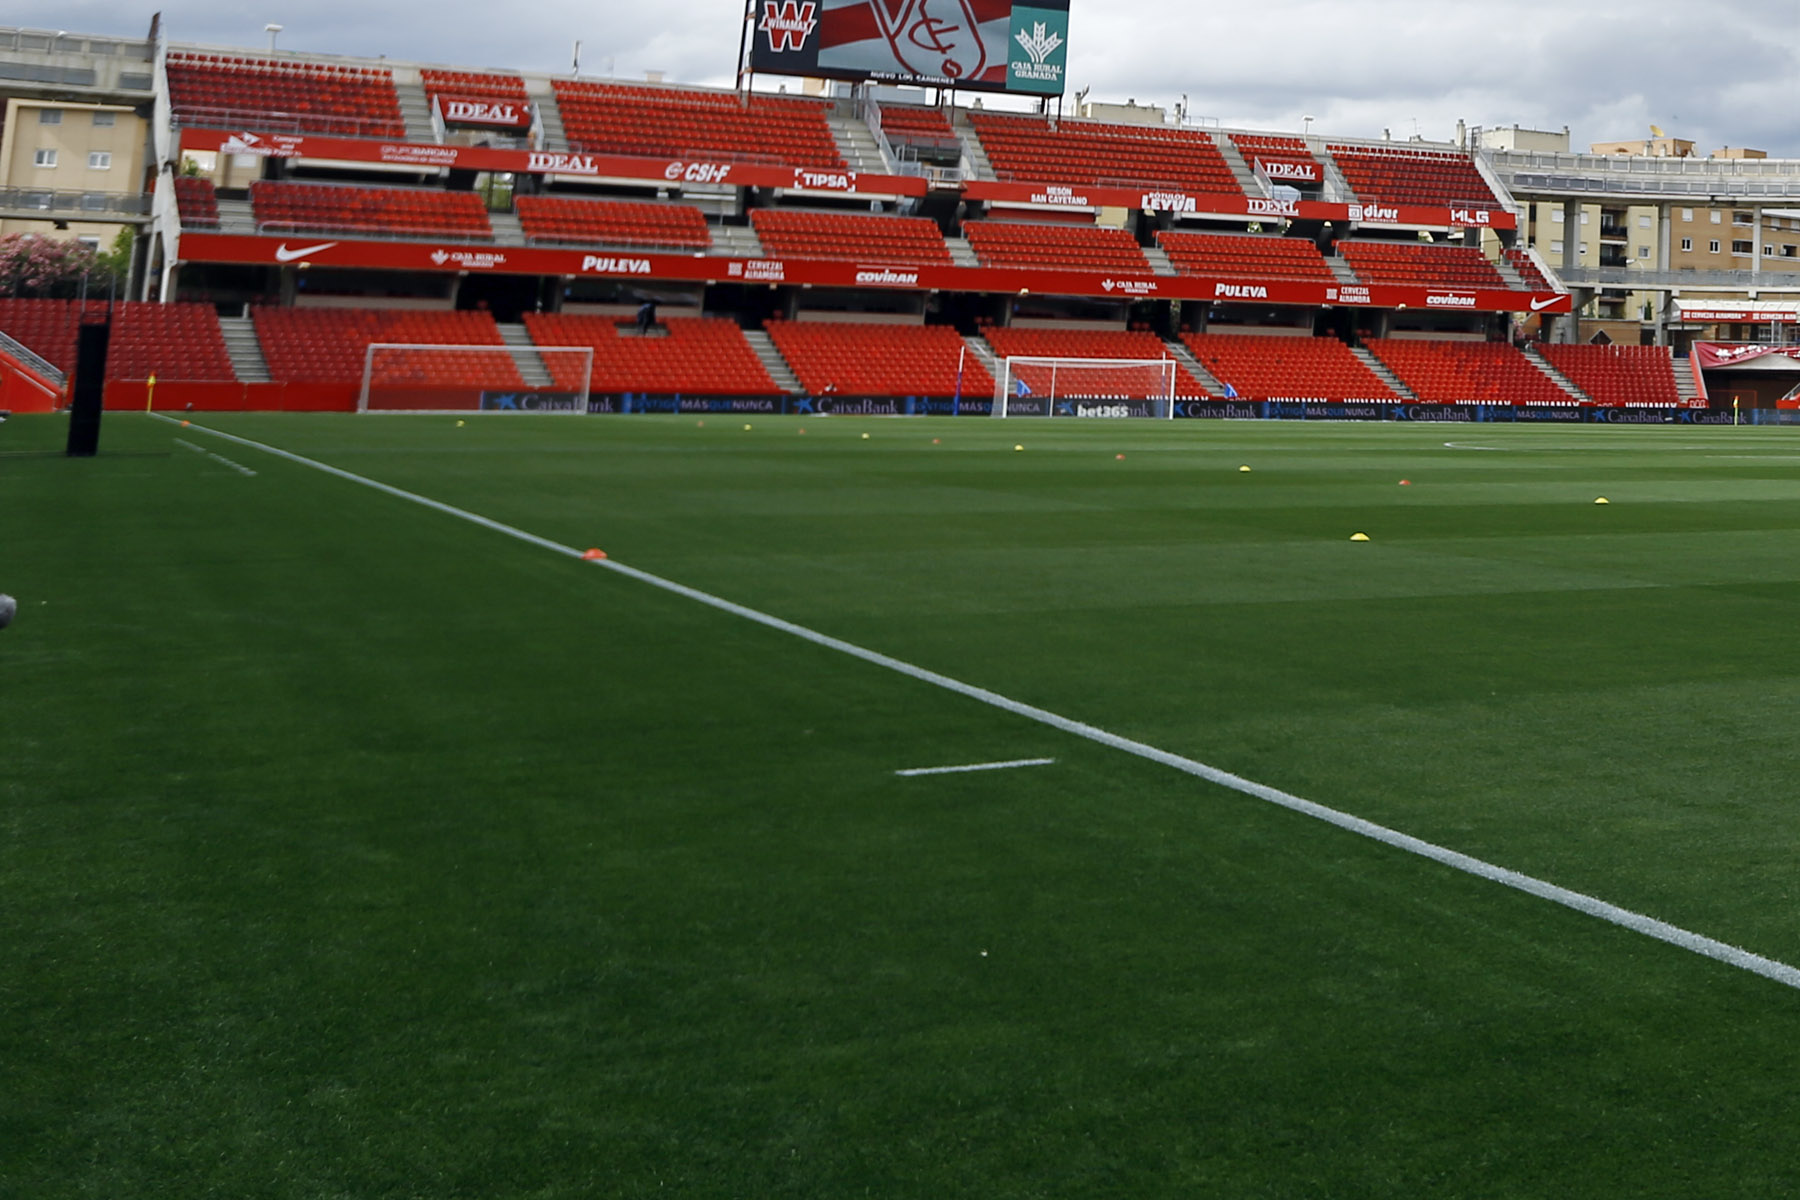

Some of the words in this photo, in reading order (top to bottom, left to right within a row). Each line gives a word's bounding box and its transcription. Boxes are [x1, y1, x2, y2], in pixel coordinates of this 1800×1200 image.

[766, 17, 811, 31] WINAMAX
[1011, 62, 1031, 71] CAJA
[1033, 63, 1063, 74] RURAL
[1015, 70, 1058, 81] GRANADA
[871, 71, 896, 80] NUEVO
[915, 75, 956, 85] CARMENES
[447, 102, 519, 123] IDEAL
[529, 153, 599, 174] IDEAL
[1265, 162, 1316, 180] IDEAL
[802, 172, 850, 188] TIPSA
[1031, 194, 1047, 203] SAN
[1048, 195, 1088, 205] CAYETANO
[1141, 195, 1196, 212] LEYVA
[1247, 199, 1299, 216] IDEAL
[1363, 204, 1398, 218] disur
[1451, 210, 1489, 224] MLG
[582, 255, 651, 273] PULEVA
[1215, 283, 1267, 298] PULEVA
[1341, 286, 1370, 295] CERVEZAS
[817, 398, 898, 414] CaixaBank
[1077, 405, 1129, 418] bet365
[1187, 403, 1257, 418] CaixaBank
[1408, 406, 1471, 421] CaixaBank
[1607, 409, 1664, 423] CaixaBank
